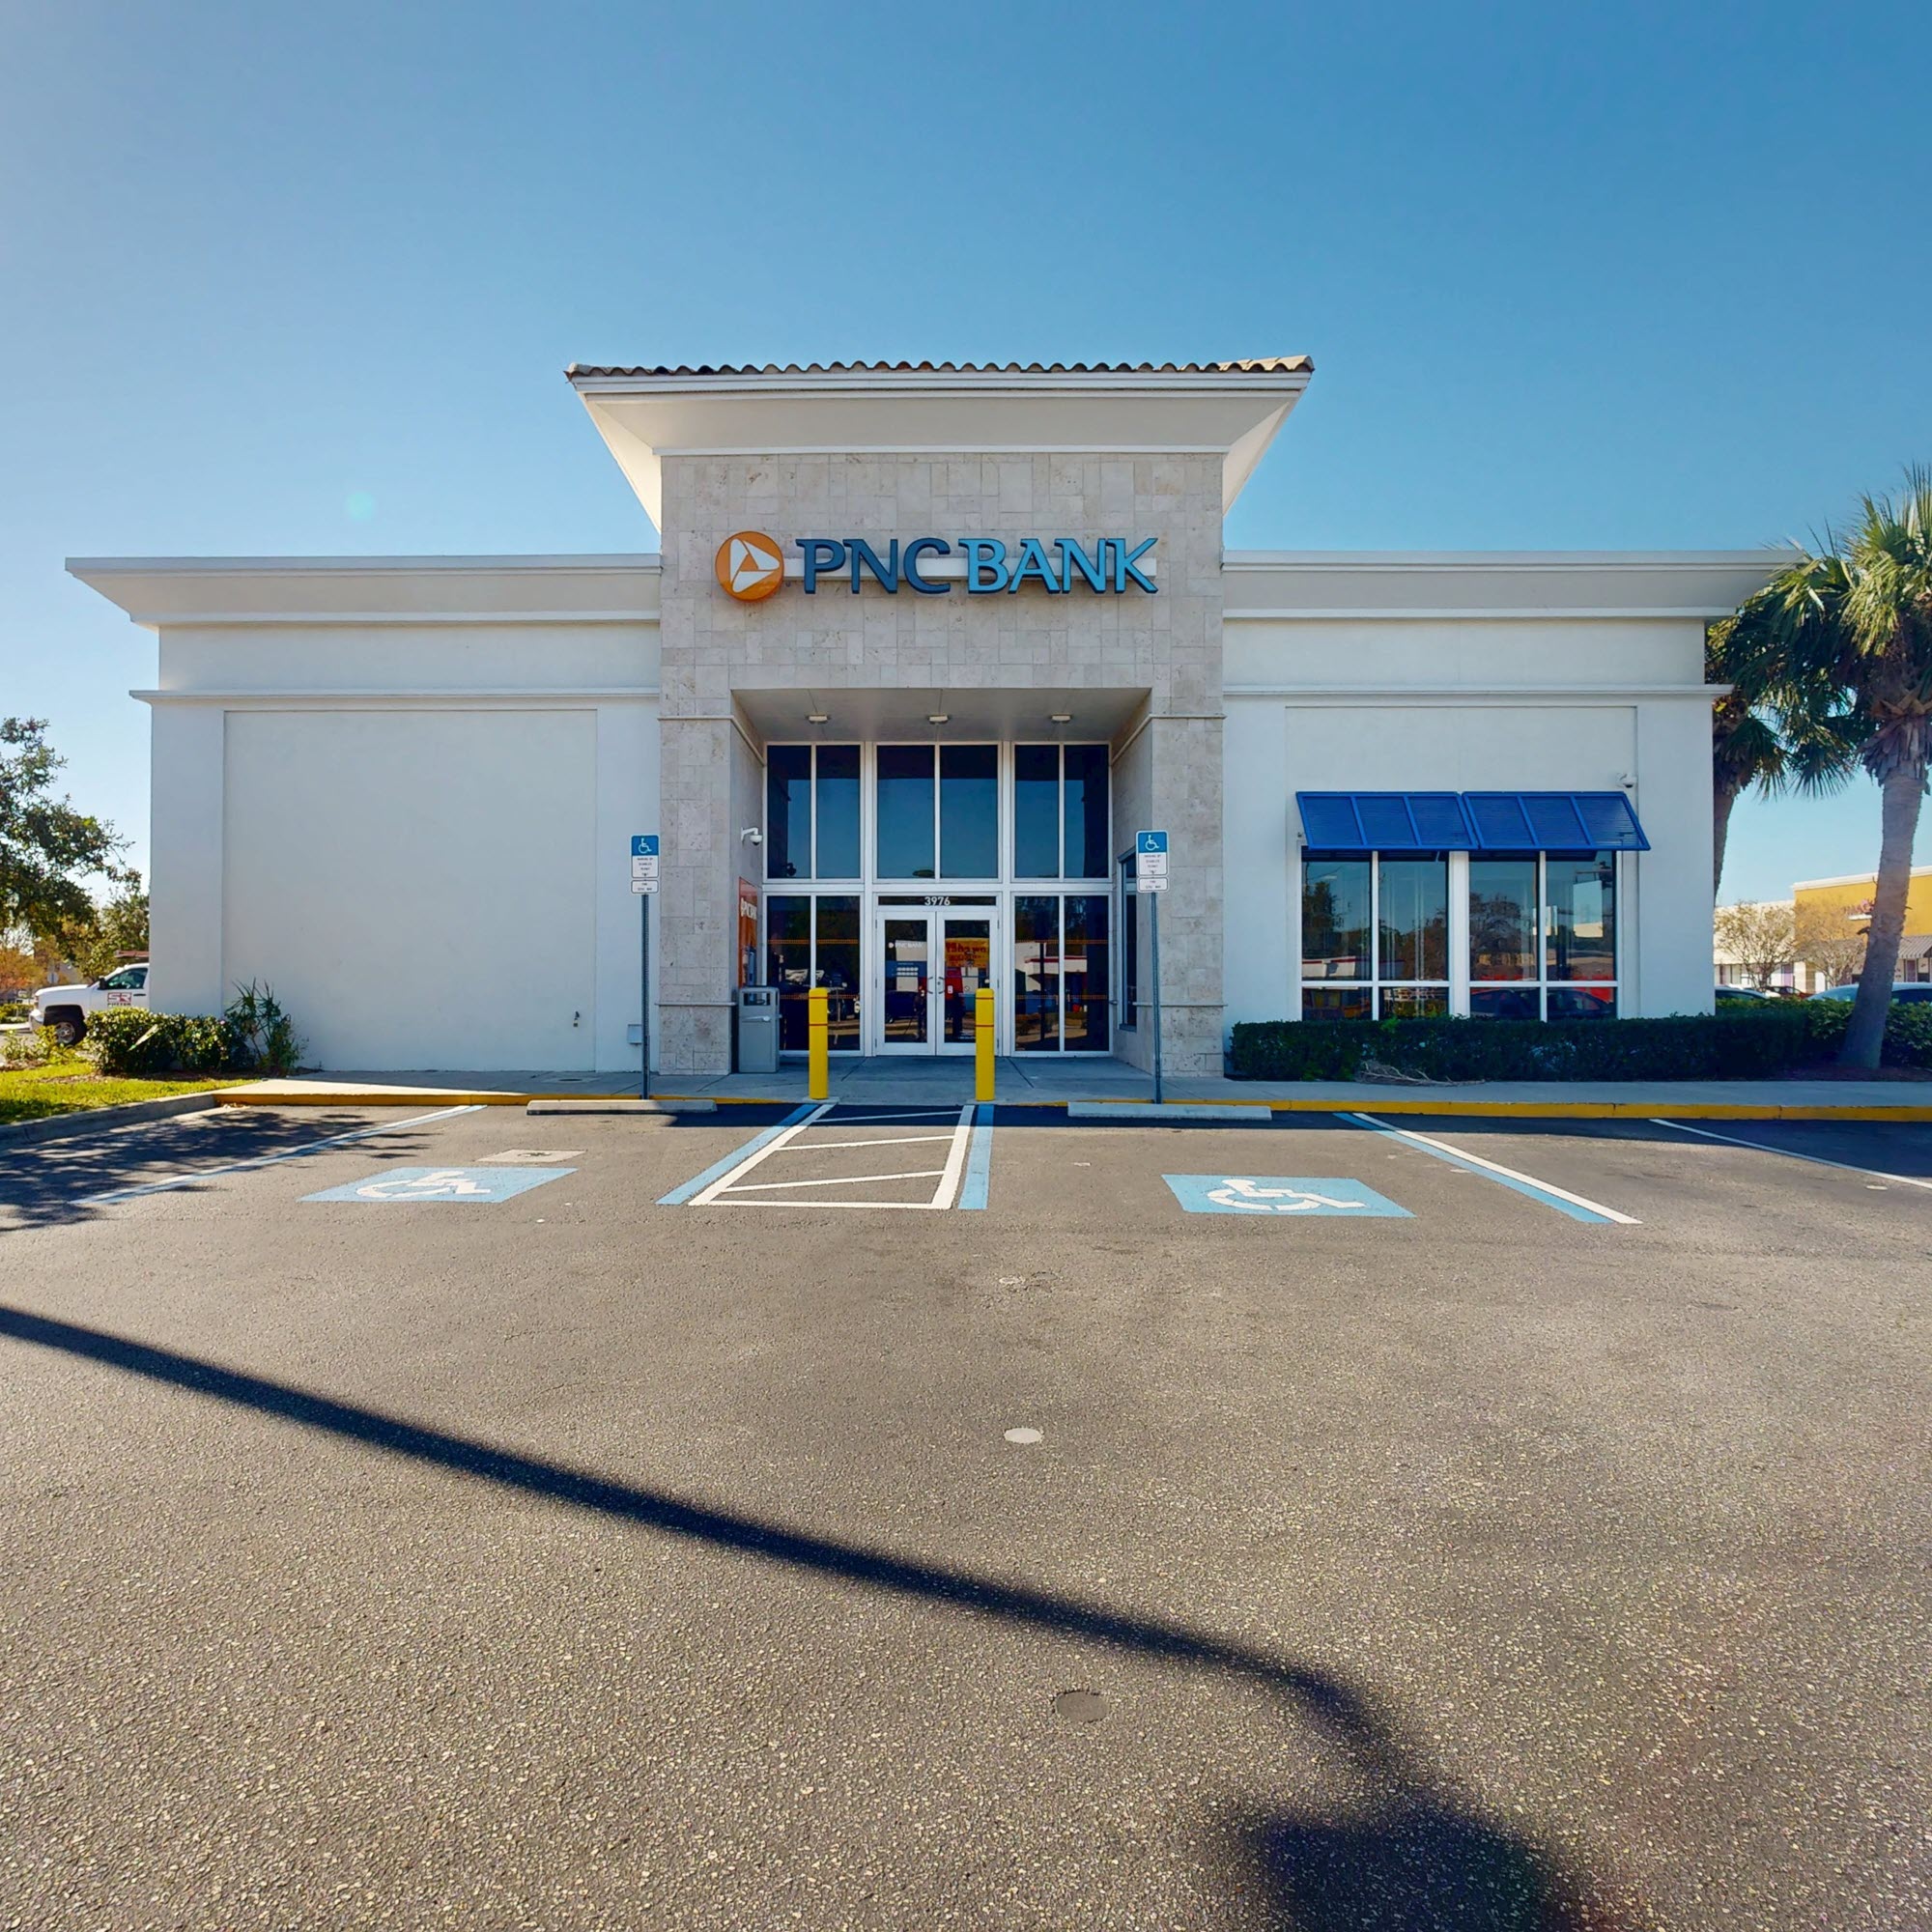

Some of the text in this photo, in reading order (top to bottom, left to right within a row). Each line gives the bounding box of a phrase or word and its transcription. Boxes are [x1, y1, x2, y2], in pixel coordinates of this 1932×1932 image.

[795, 537, 1159, 594] PNC BANK
[923, 896, 951, 906] 3976
